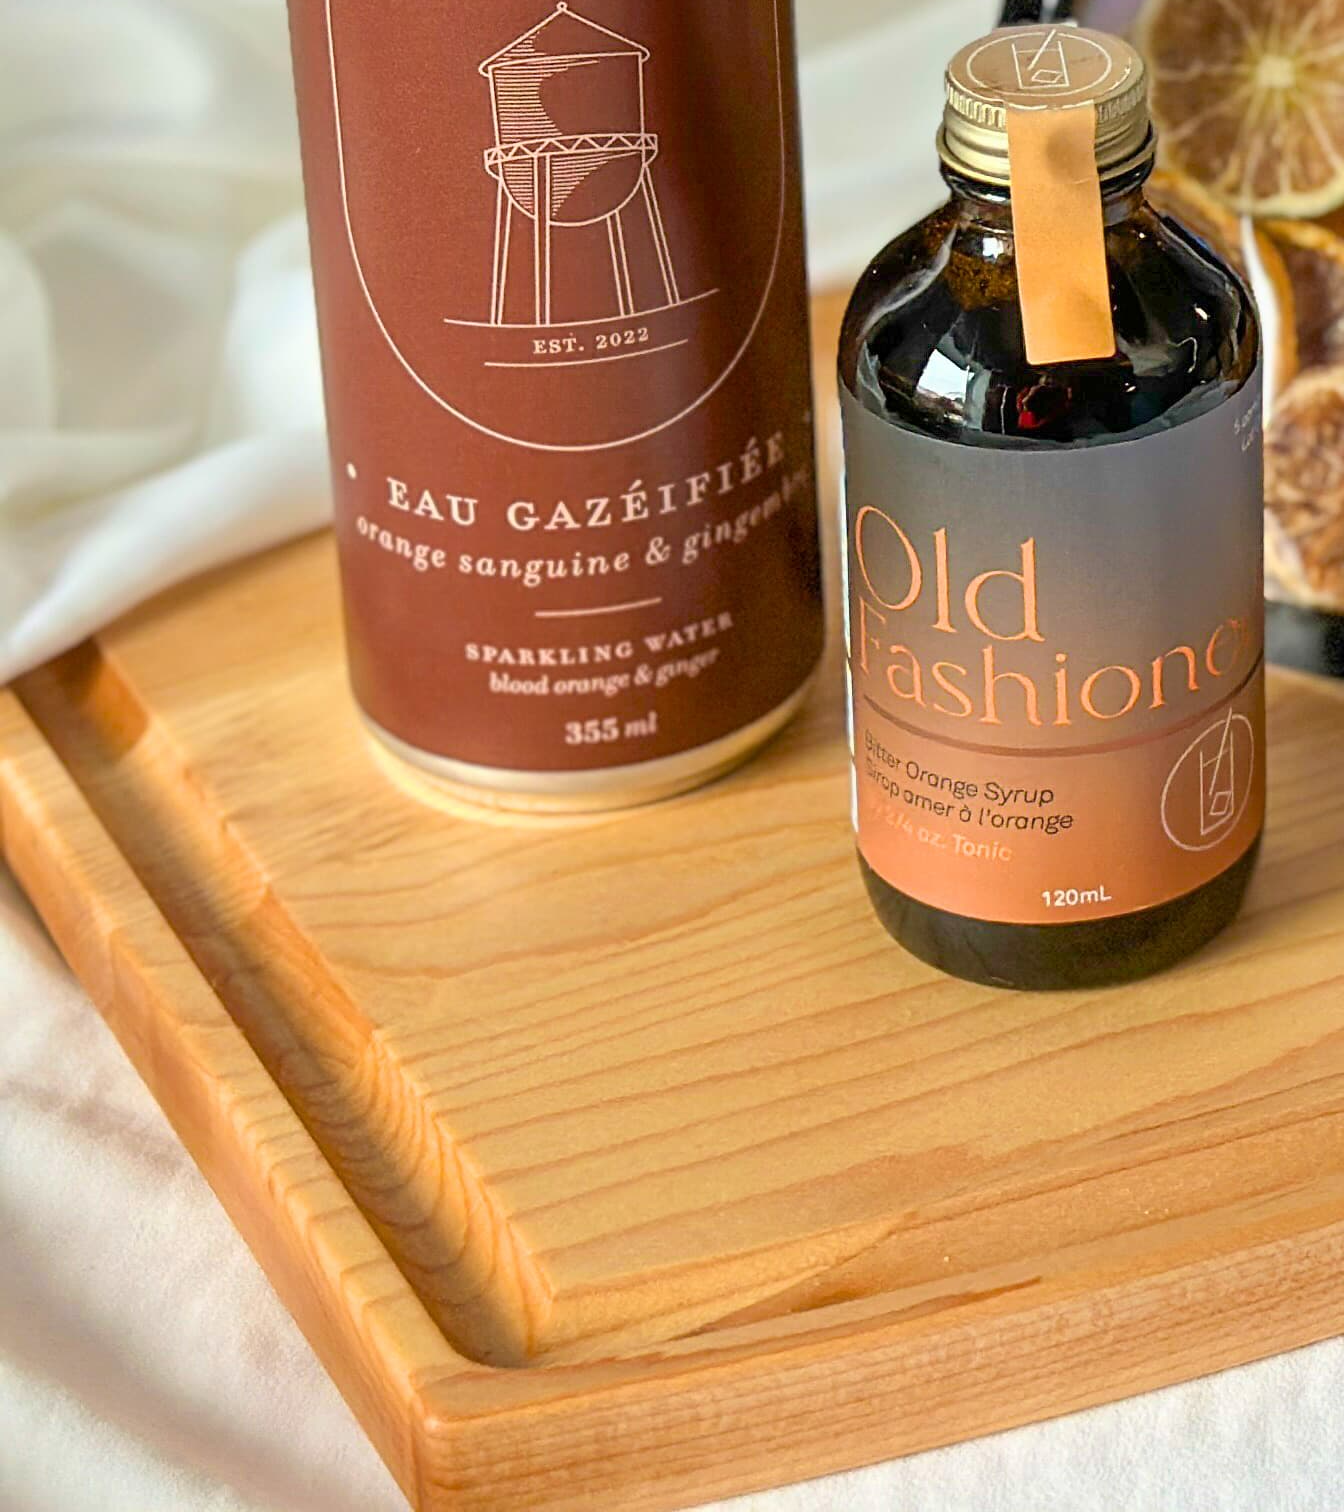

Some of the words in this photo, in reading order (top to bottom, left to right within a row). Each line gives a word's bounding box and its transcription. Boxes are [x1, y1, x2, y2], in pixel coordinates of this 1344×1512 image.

[532, 335, 585, 356] EST.
[595, 326, 651, 350] 2022
[386, 476, 479, 527] EAU
[506, 430, 786, 532] GAZÉIFIÉE
[356, 514, 447, 572] orange
[458, 549, 630, 588] sanguine
[644, 535, 673, 567] &
[854, 503, 1046, 643] Old
[464, 640, 634, 667] SPARKLING
[643, 611, 735, 652] WATER
[488, 671, 550, 696] blood
[552, 672, 630, 698] orange
[633, 663, 653, 686] &
[654, 647, 720, 688] ginger
[564, 716, 620, 745] 355
[623, 710, 659, 738] ml
[864, 727, 902, 770] Bitter
[905, 760, 979, 801] Orange
[983, 781, 1056, 808] Syrup
[902, 788, 956, 818] amer
[958, 803, 973, 823] à
[978, 807, 1075, 836] l'orange
[950, 832, 1014, 862] Tonic
[1040, 884, 1113, 909] 120mL
